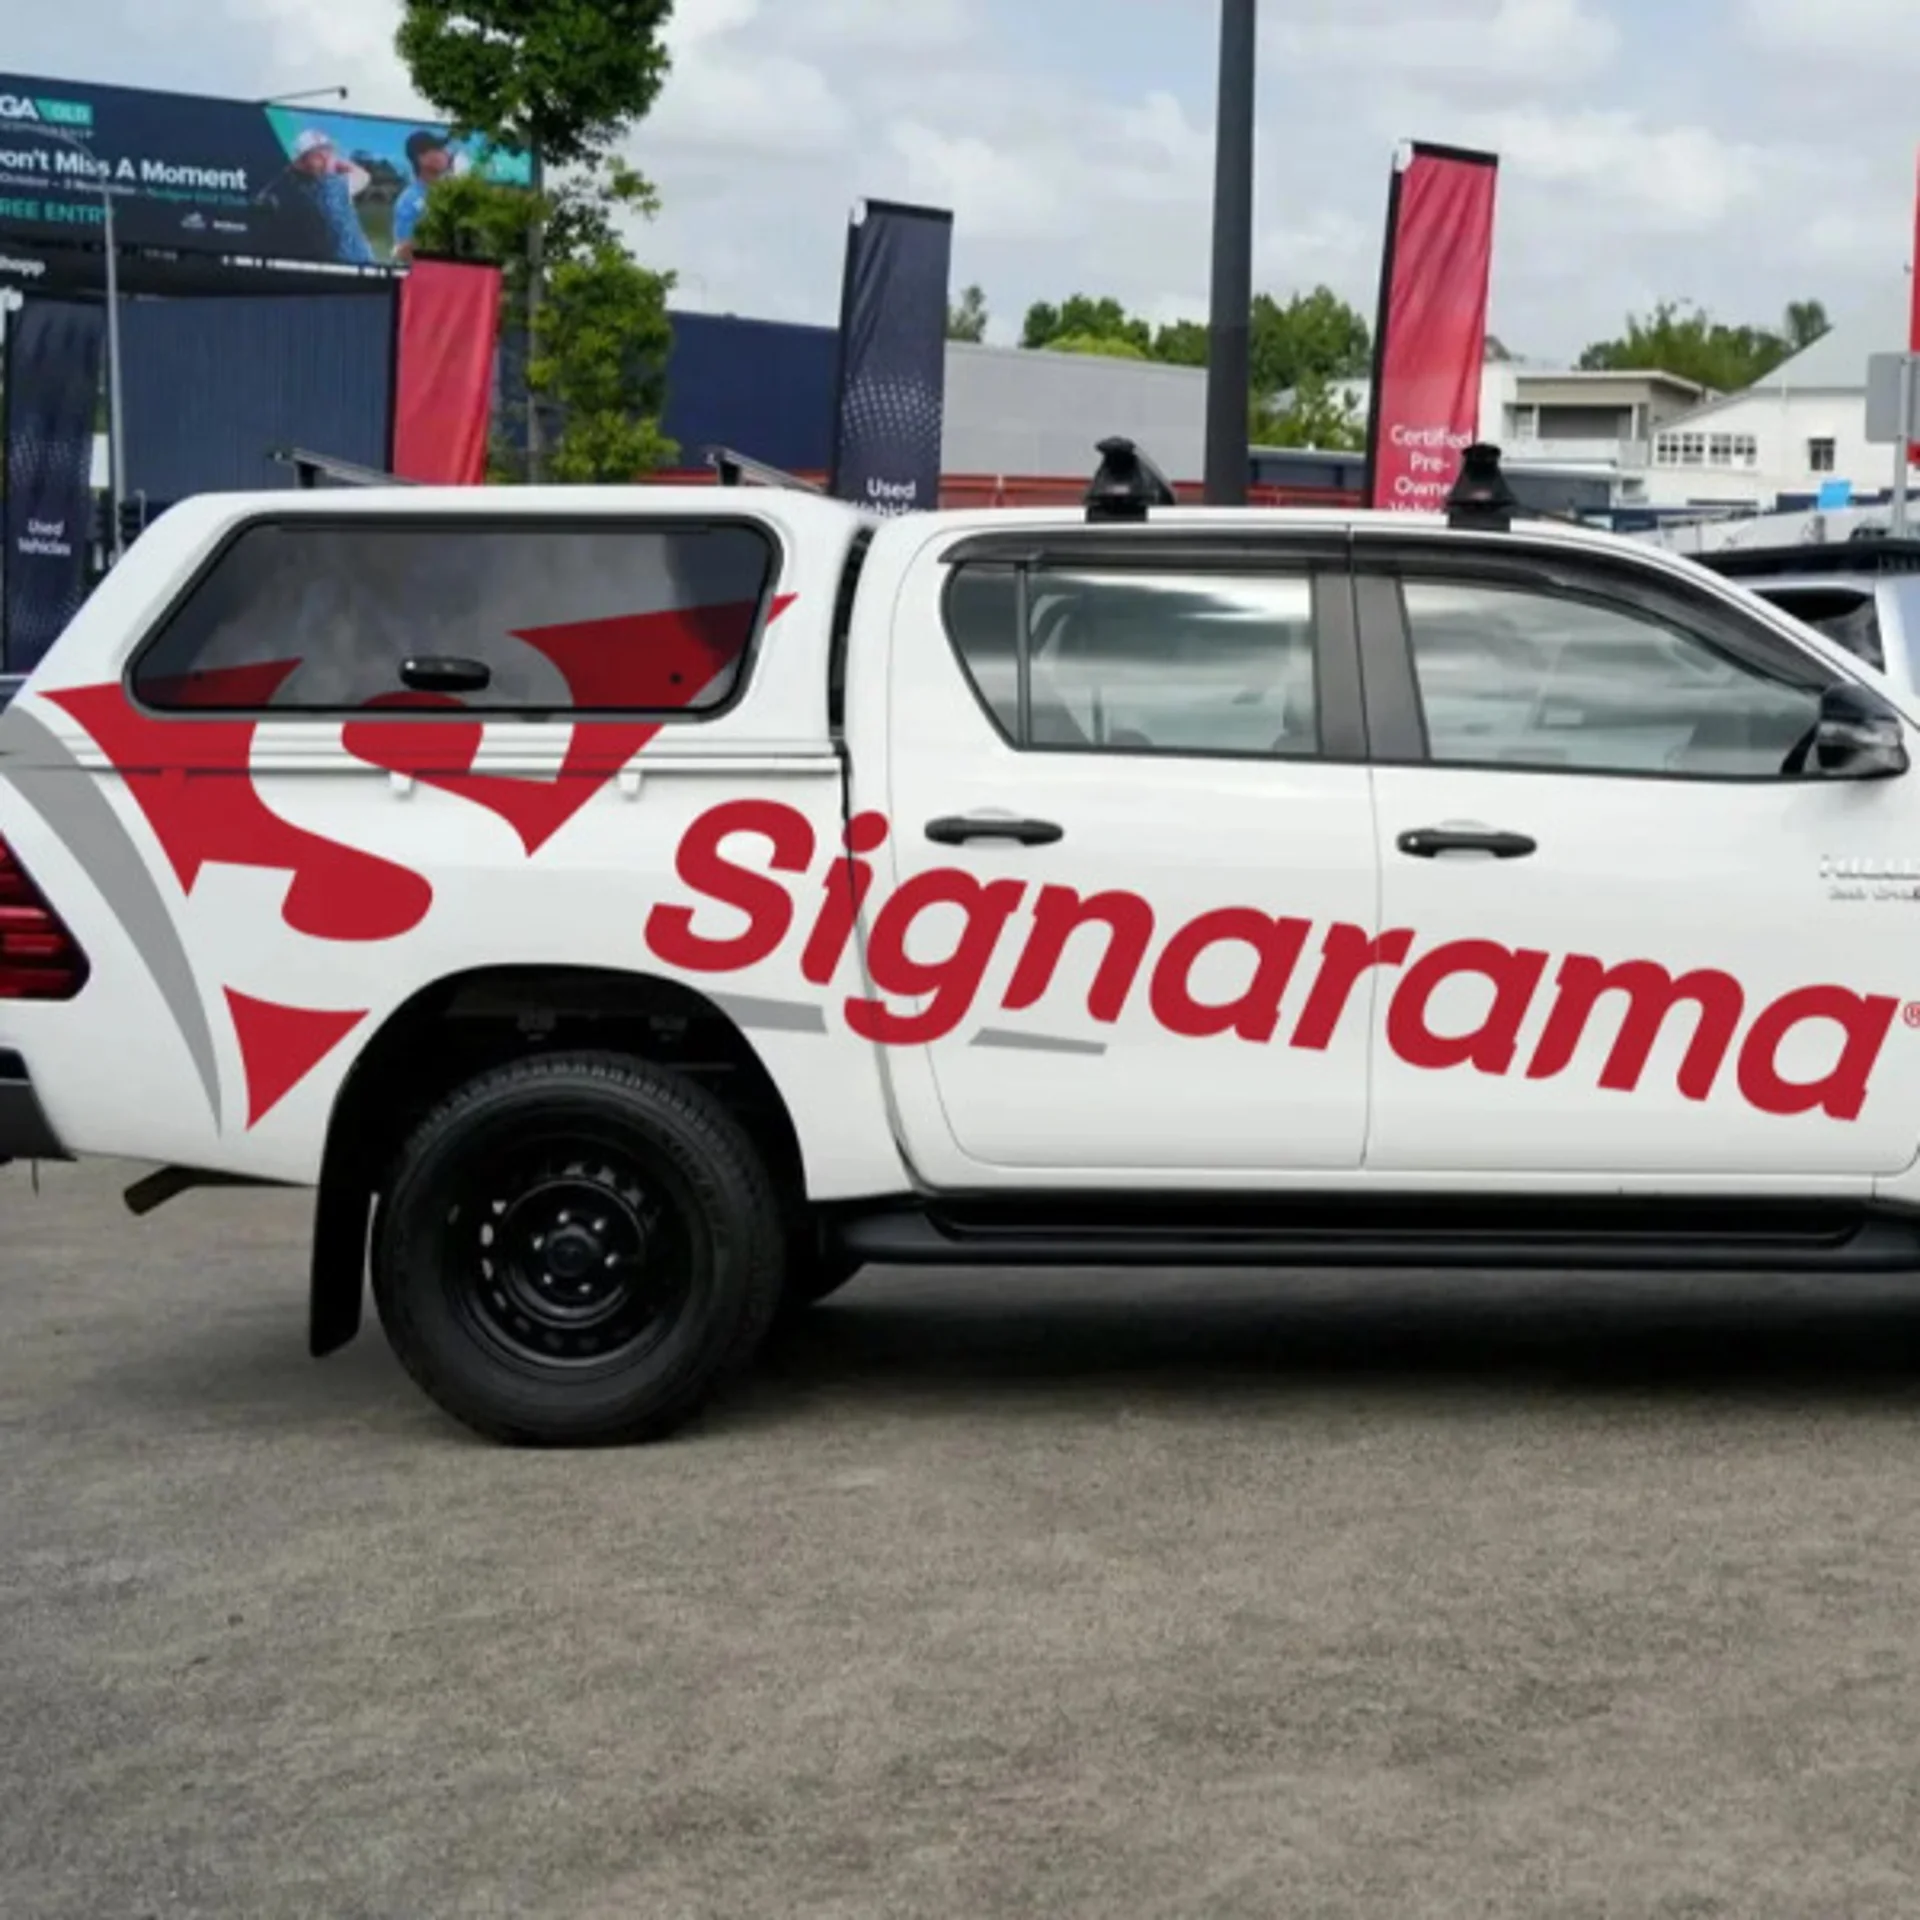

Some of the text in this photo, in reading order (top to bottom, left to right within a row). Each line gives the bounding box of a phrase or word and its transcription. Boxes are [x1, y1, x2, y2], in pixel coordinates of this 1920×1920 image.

[55, 150, 111, 178] Miss
[115, 157, 136, 181] A
[141, 160, 249, 190] Moment
[1410, 451, 1451, 473] Pre-
[866, 477, 917, 500] Used
[1394, 476, 1452, 497] Owne
[27, 518, 66, 537] Used
[645, 798, 1901, 1121] Signarama
